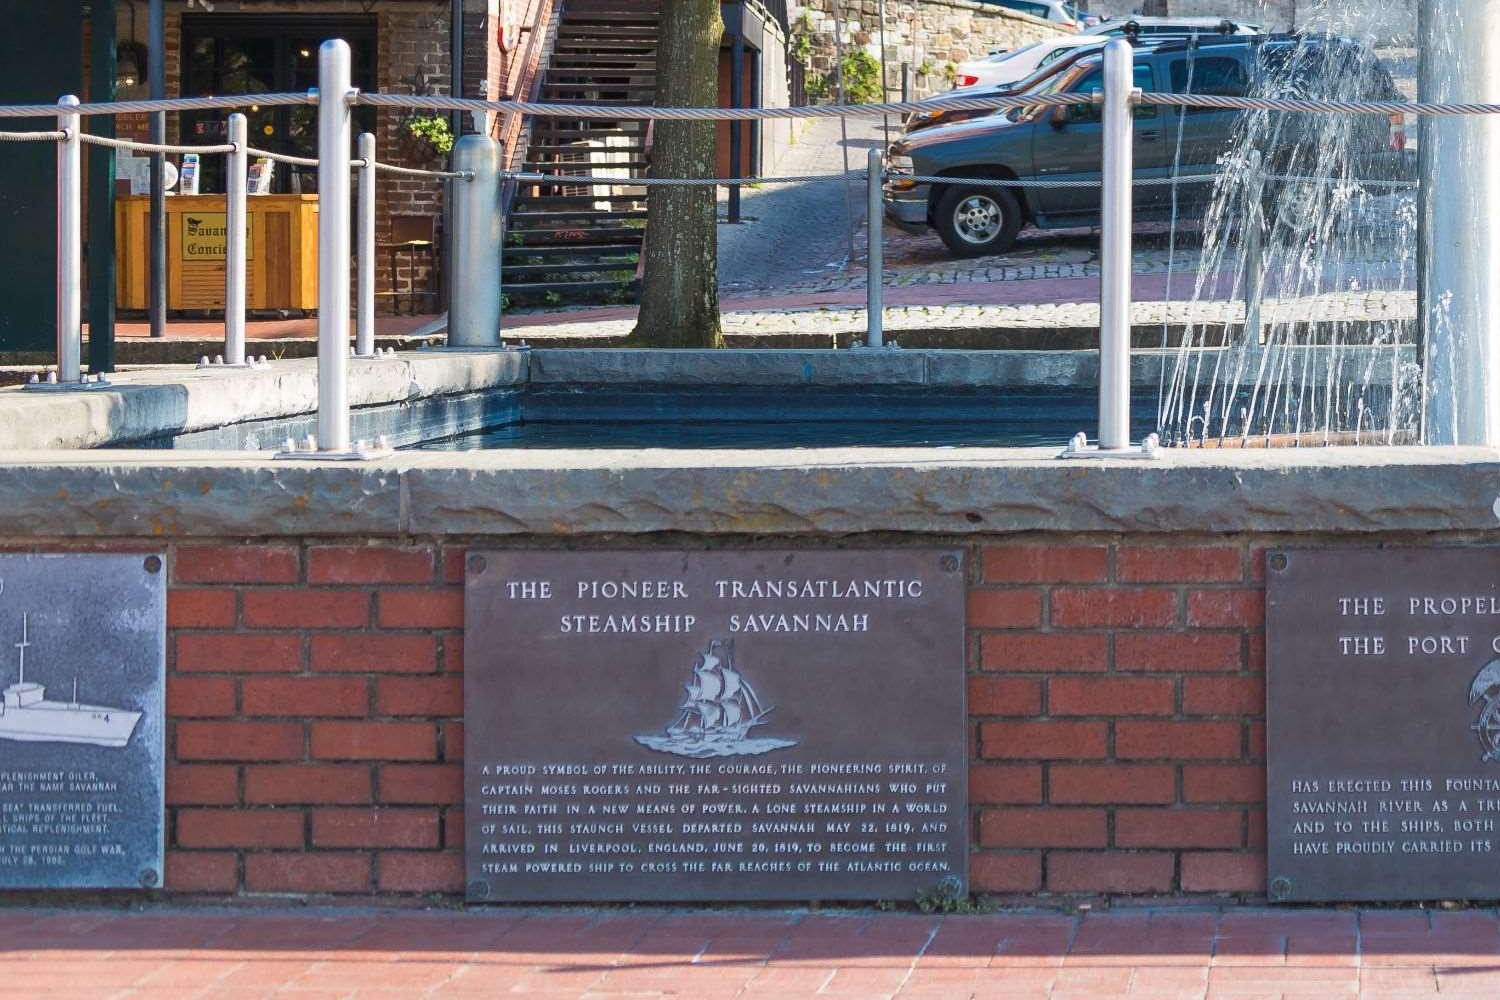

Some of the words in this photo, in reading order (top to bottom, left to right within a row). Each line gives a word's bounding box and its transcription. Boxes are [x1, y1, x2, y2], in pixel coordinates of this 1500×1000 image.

[506, 580, 552, 600] THE
[578, 580, 688, 599] PIONEER
[714, 580, 922, 598] TRANSATLANTIC
[1338, 597, 1384, 616] THE
[560, 615, 695, 632] STEAMSHIP
[729, 614, 868, 632] SAVANNAH
[1338, 637, 1384, 655] THE
[1408, 636, 1468, 654] PORT
[1292, 780, 1318, 792] HAS
[1328, 780, 1390, 792] ERECTED
[1400, 780, 1432, 792] THIS
[482, 804, 516, 814] THEIR
[524, 804, 556, 814] FAITH
[566, 804, 579, 814] IN
[588, 804, 595, 814] A
[602, 804, 628, 814] NEW
[636, 804, 675, 814] MEANS
[680, 804, 694, 814] OF
[751, 804, 759, 814] A
[766, 804, 796, 814] LONE
[803, 804, 866, 814] STEAMSHIP
[872, 804, 885, 814] IN
[892, 804, 899, 814] A
[905, 804, 947, 814] WORLD
[1292, 800, 1366, 813] SAVANNAH
[1379, 800, 1422, 813] RIVER
[1432, 800, 1448, 812] AS
[1458, 800, 1467, 812] A
[481, 824, 495, 834] OF
[537, 824, 562, 834] THIS
[570, 824, 623, 834] STAUNCH
[632, 824, 672, 834] VESSEL
[682, 824, 742, 834] DEPARTED
[752, 824, 814, 833] SAVANNAH
[826, 824, 850, 833] MAY
[921, 824, 946, 833] AND
[1293, 821, 1324, 834] AND
[1334, 821, 1352, 833] TO
[1362, 820, 1388, 833] THE
[1401, 820, 1443, 833] SHIPS,
[1454, 820, 1493, 832] BOTH
[1293, 842, 1328, 854] HAVE
[1336, 841, 1394, 854] PROUDLY
[1402, 841, 1462, 854] CARRIED
[1470, 841, 1491, 853] ITS
[482, 863, 517, 873] STEAM
[525, 863, 582, 873] POWERED
[588, 863, 614, 873] SHIP
[618, 863, 633, 873] TO
[640, 863, 676, 873] CROSS
[682, 863, 704, 873] THE
[711, 863, 732, 872] FAR
[739, 863, 791, 872] REACHES
[797, 863, 811, 872] OF
[818, 863, 839, 872] THE
[847, 863, 901, 872] ATLANTIC
